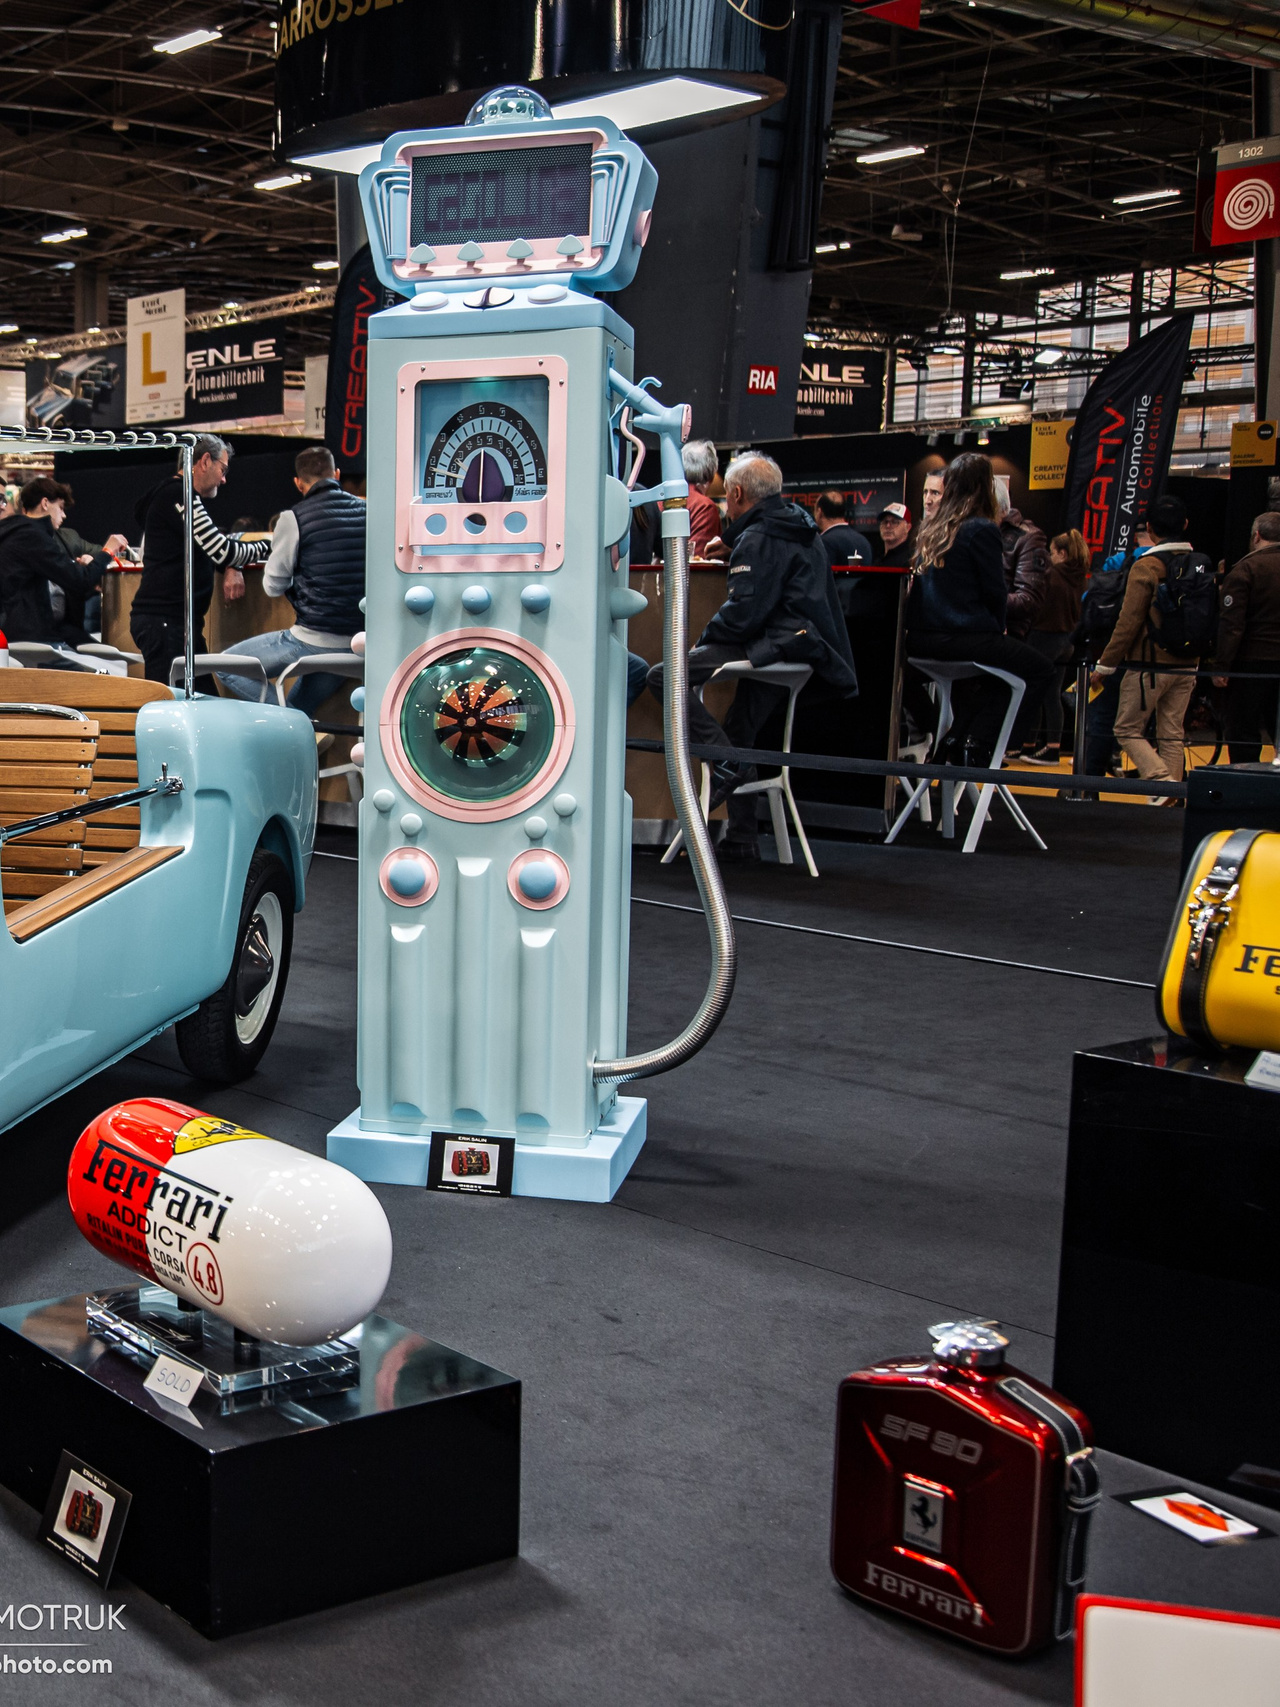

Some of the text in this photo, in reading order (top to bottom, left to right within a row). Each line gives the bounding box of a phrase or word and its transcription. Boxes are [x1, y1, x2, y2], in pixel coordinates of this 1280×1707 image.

[1238, 145, 1264, 159] 1302
[142, 331, 168, 387] L
[186, 338, 277, 370] ENLE
[184, 365, 266, 400] Automobiltechnik
[748, 368, 776, 390] RIA
[1121, 394, 1151, 515] Automobile
[1139, 394, 1164, 490] Collection
[82, 1139, 234, 1243] Ferrari
[107, 1201, 188, 1252] ADDICT
[153, 1247, 188, 1277] CORSA
[193, 1256, 219, 1296] 4.8
[156, 1366, 191, 1394] SOLD
[863, 1561, 987, 1627] Ferrari
